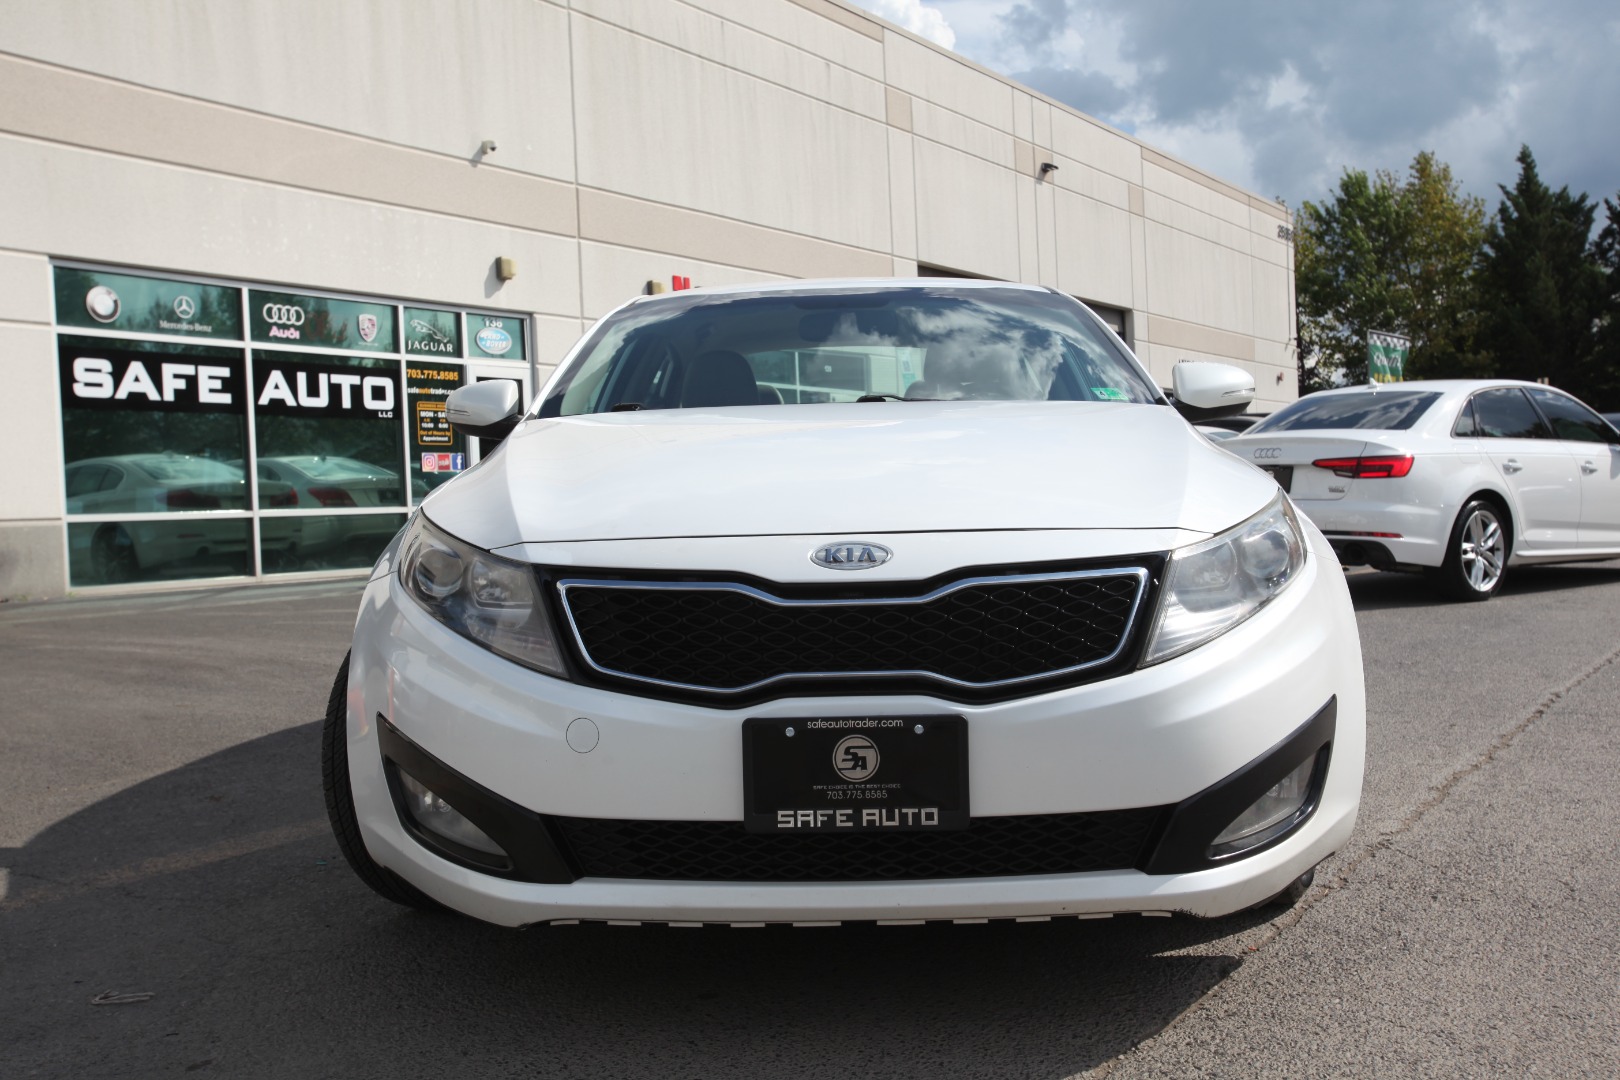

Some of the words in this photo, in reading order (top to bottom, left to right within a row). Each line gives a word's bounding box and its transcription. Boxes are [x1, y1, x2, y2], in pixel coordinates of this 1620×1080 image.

[269, 325, 300, 340] Audi
[407, 340, 454, 353] JAGUAR
[407, 369, 458, 380] 703.775.8585
[72, 356, 232, 404] SAFE
[257, 369, 395, 411] AUTO
[824, 547, 877, 563] KIA
[807, 718, 904, 729] safeautotrader.com
[826, 790, 888, 800] 703.775.8585
[777, 809, 854, 828] SAFE
[862, 807, 939, 827] AUTO
